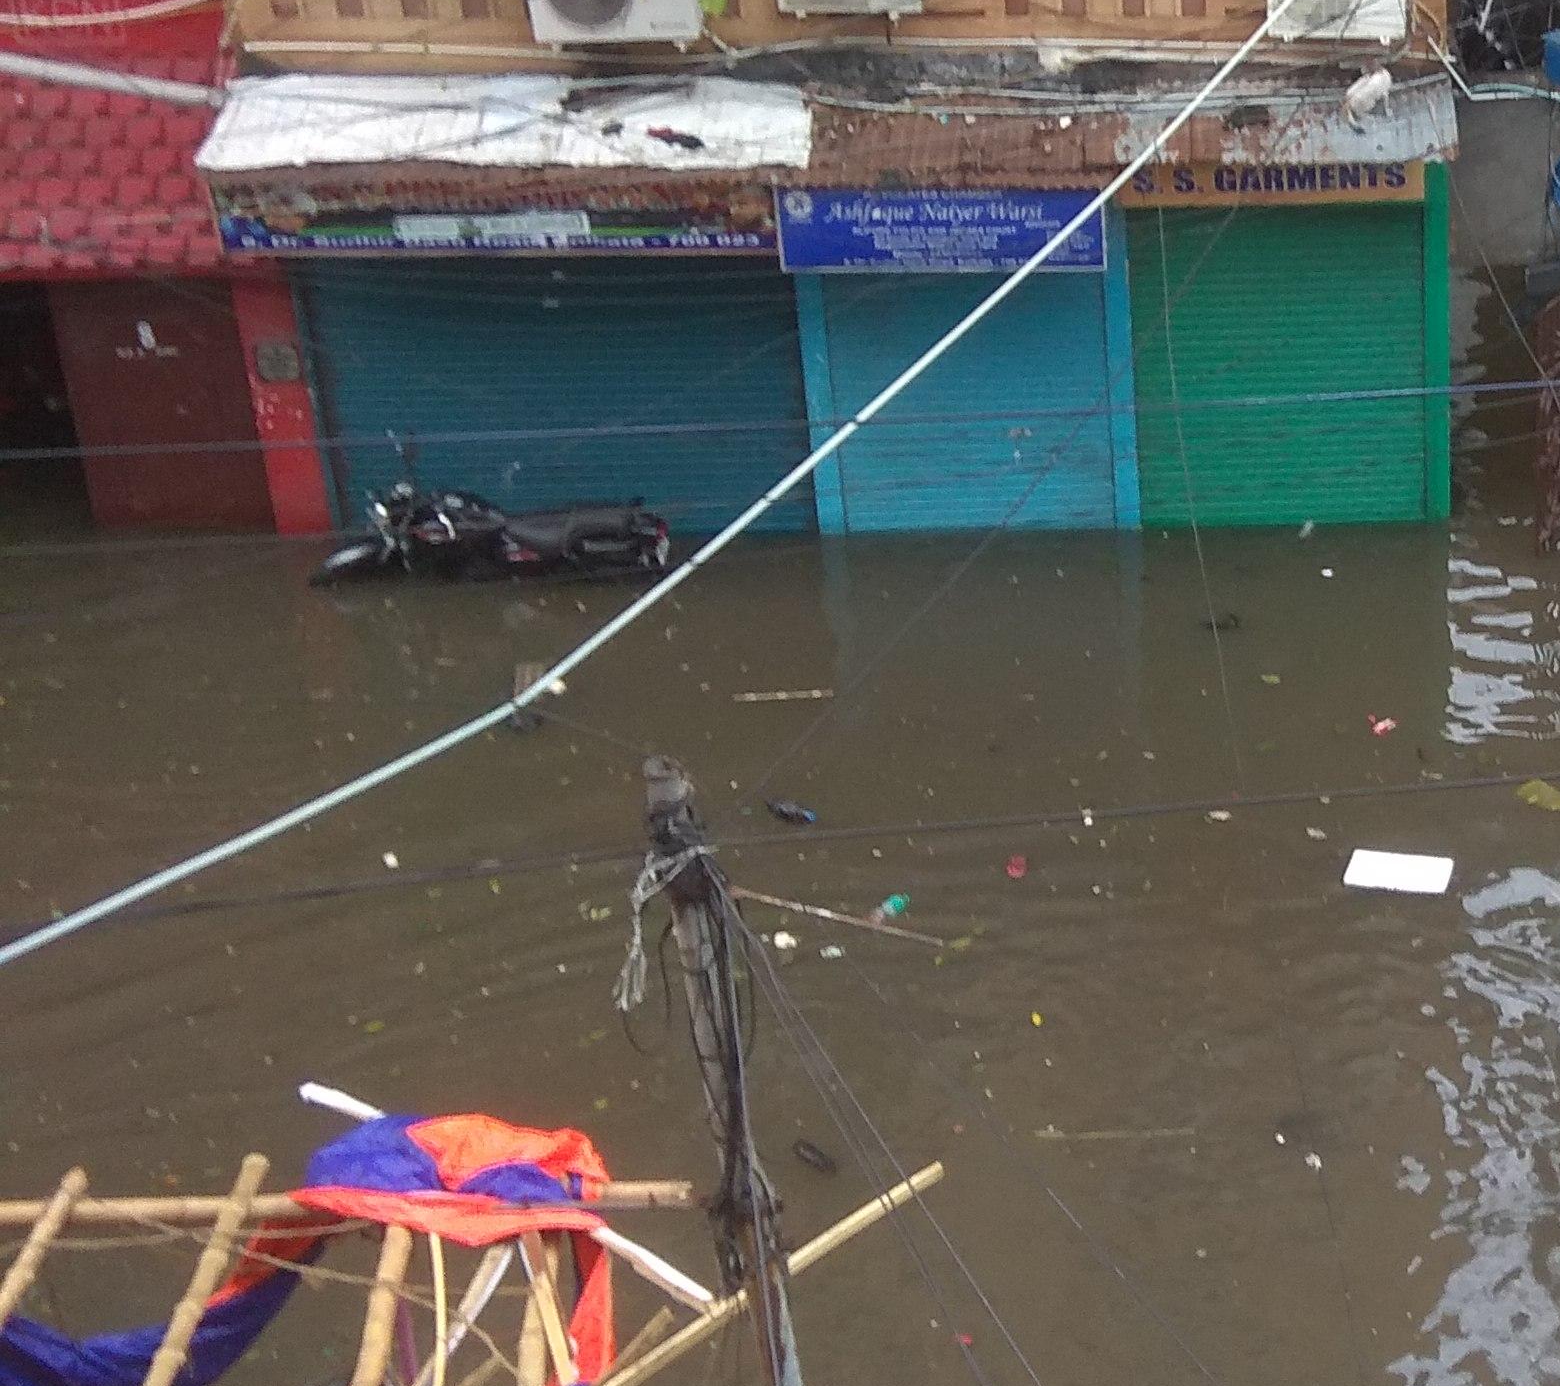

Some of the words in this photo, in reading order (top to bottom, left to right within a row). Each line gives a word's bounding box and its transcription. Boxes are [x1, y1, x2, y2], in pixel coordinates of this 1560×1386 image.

[1132, 169, 1163, 193] S.
[1173, 168, 1203, 193] S.
[1214, 163, 1406, 192] GARMENTS
